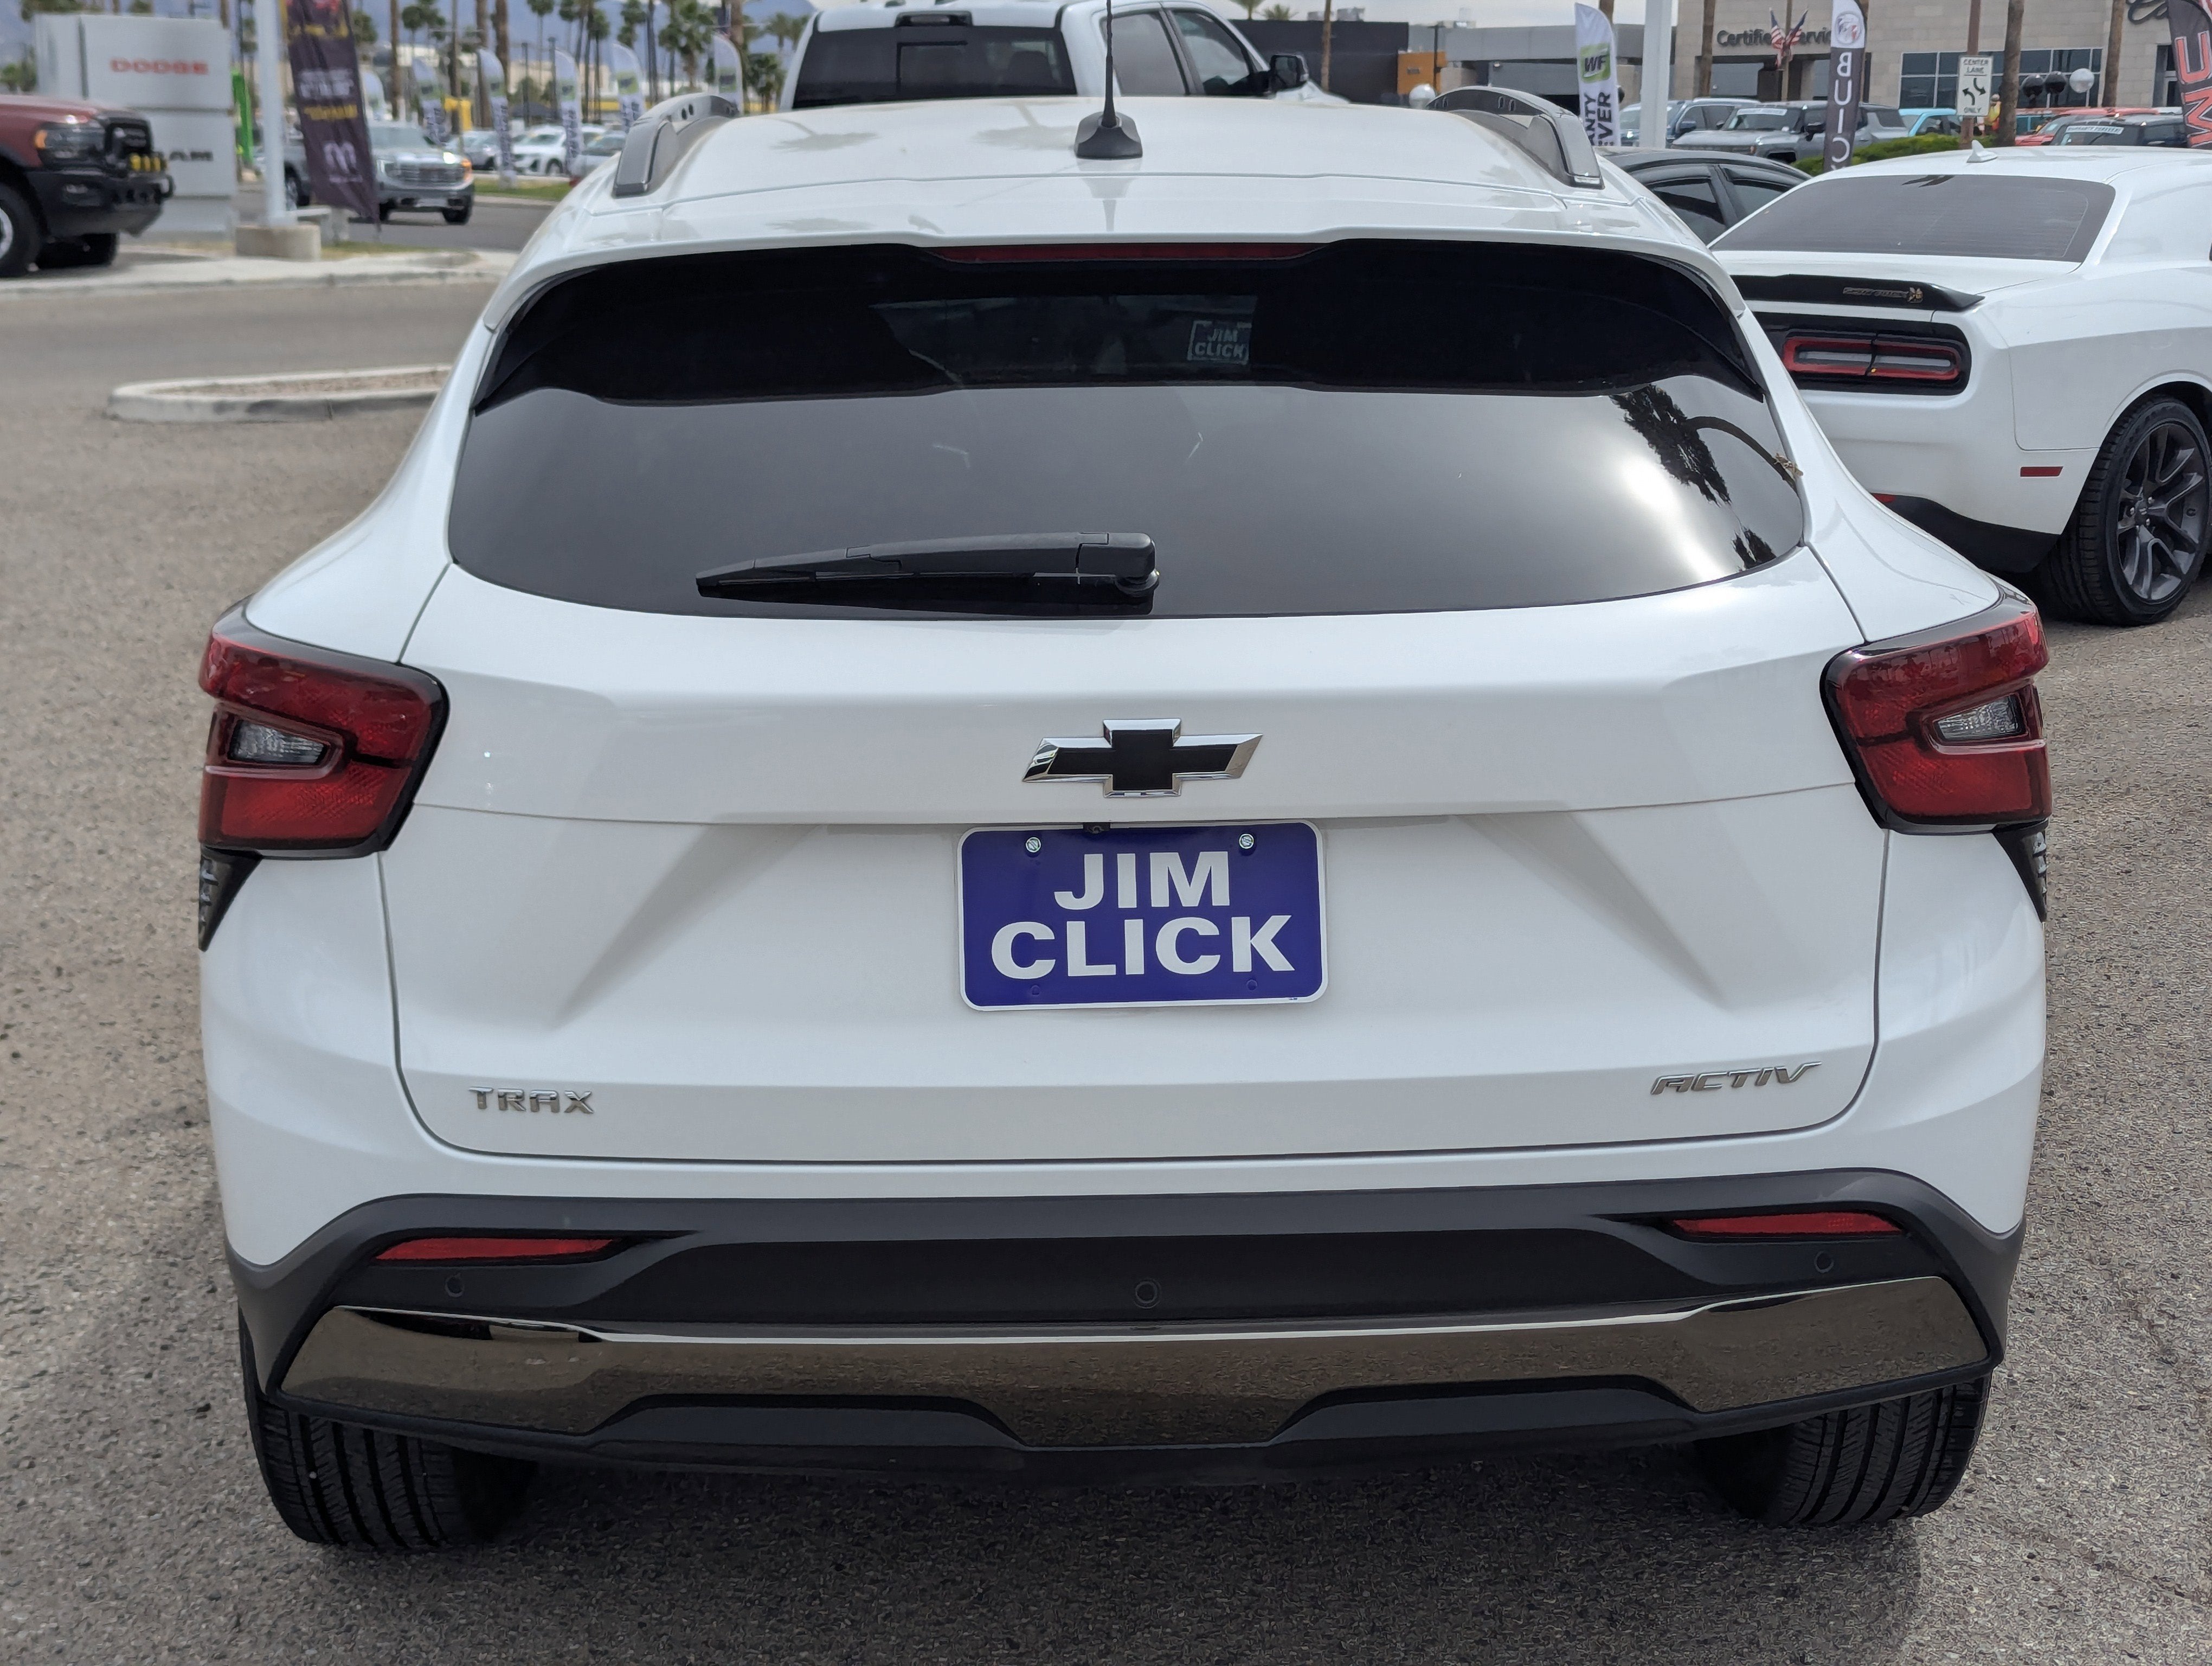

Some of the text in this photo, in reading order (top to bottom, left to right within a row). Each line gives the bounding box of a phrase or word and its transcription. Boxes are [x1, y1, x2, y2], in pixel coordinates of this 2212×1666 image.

[1717, 29, 1772, 46] Certifie
[110, 58, 208, 75] DODGE
[1584, 55, 1606, 72] WF
[1584, 92, 1596, 145] ANTY
[1597, 92, 1613, 145] VER
[169, 151, 214, 162] AM
[1207, 329, 1238, 342] JIM
[1195, 342, 1246, 358] CLICK
[1054, 851, 1230, 910] JIM
[991, 915, 1295, 979] CLICK
[1651, 1061, 1822, 1095] ACTIV
[468, 1086, 594, 1113] TRAX
